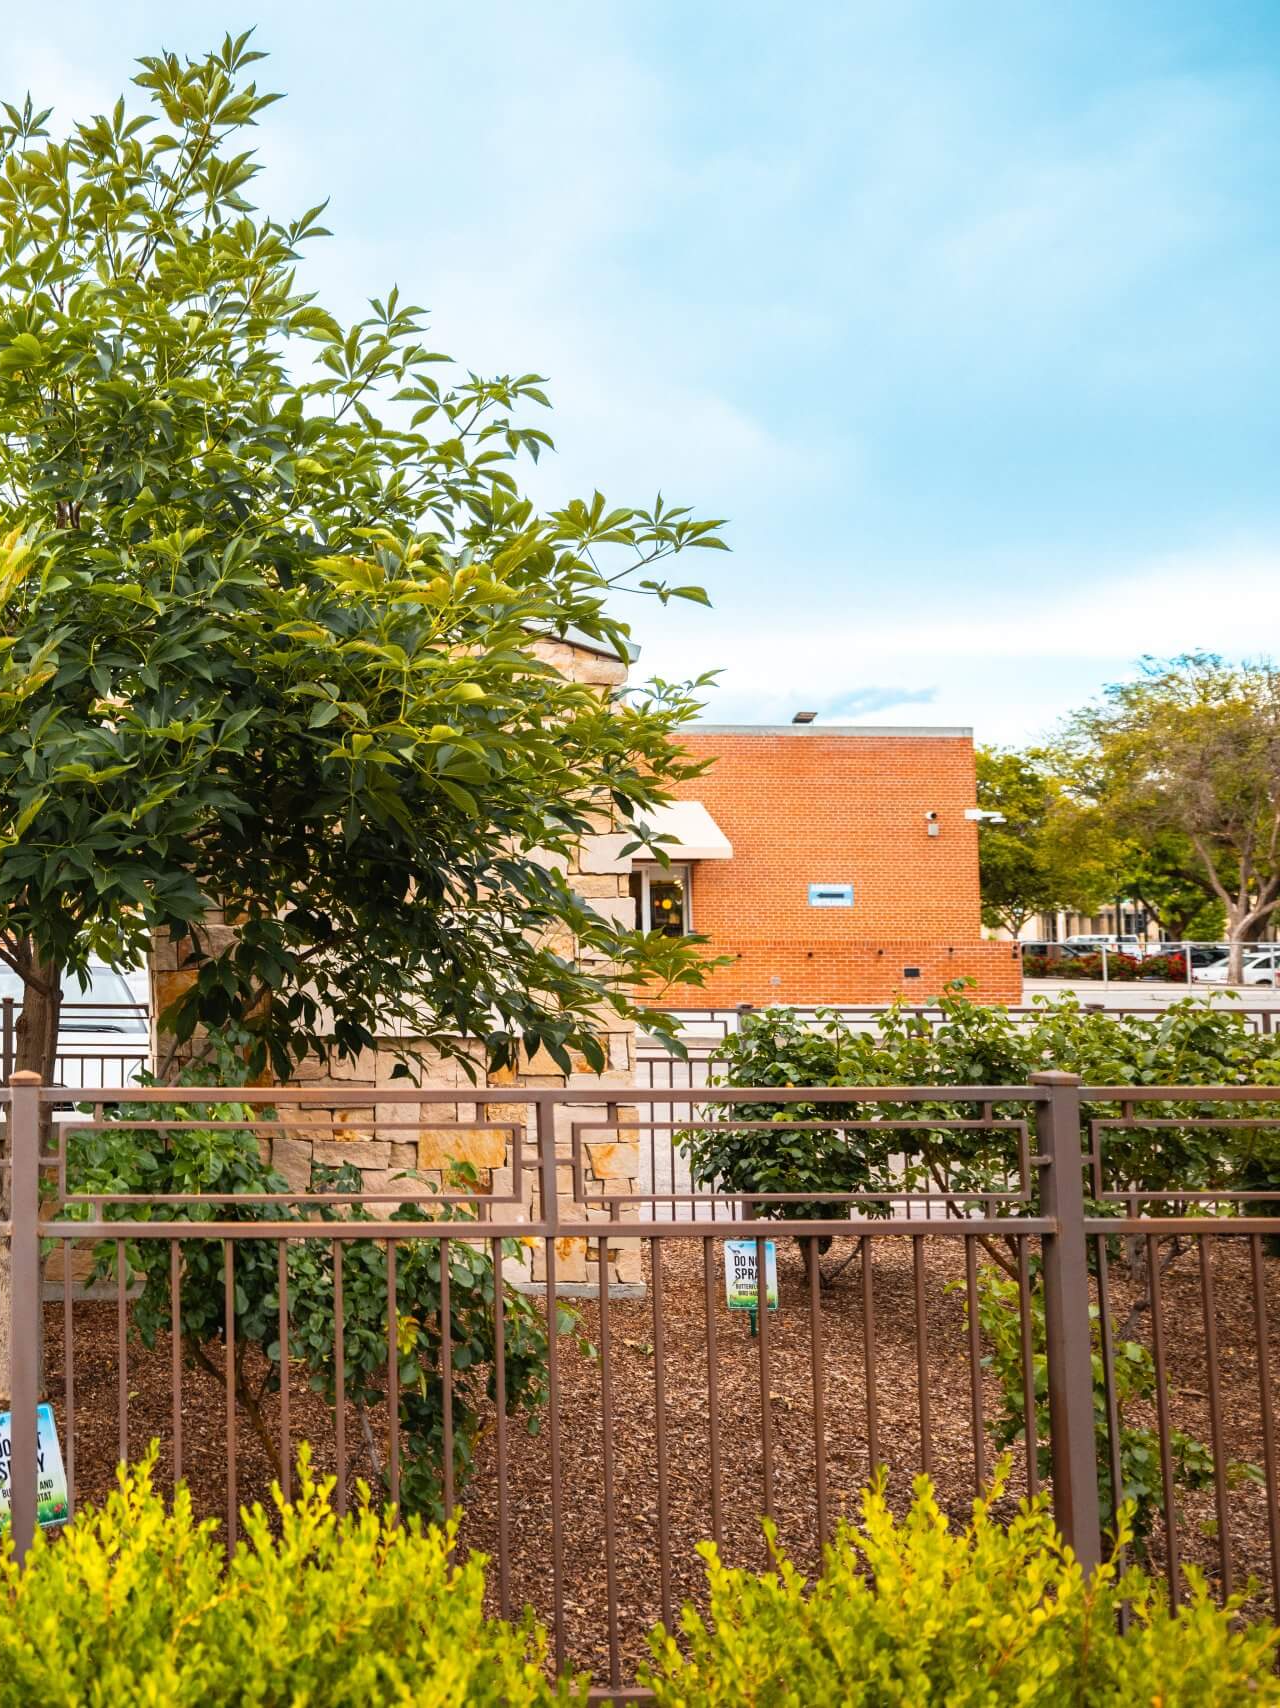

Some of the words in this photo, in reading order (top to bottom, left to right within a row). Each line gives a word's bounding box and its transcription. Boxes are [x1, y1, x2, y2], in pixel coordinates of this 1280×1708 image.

[734, 1255, 746, 1267] DO
[735, 1268, 759, 1280] SPRA
[40, 1479, 54, 1490] AND
